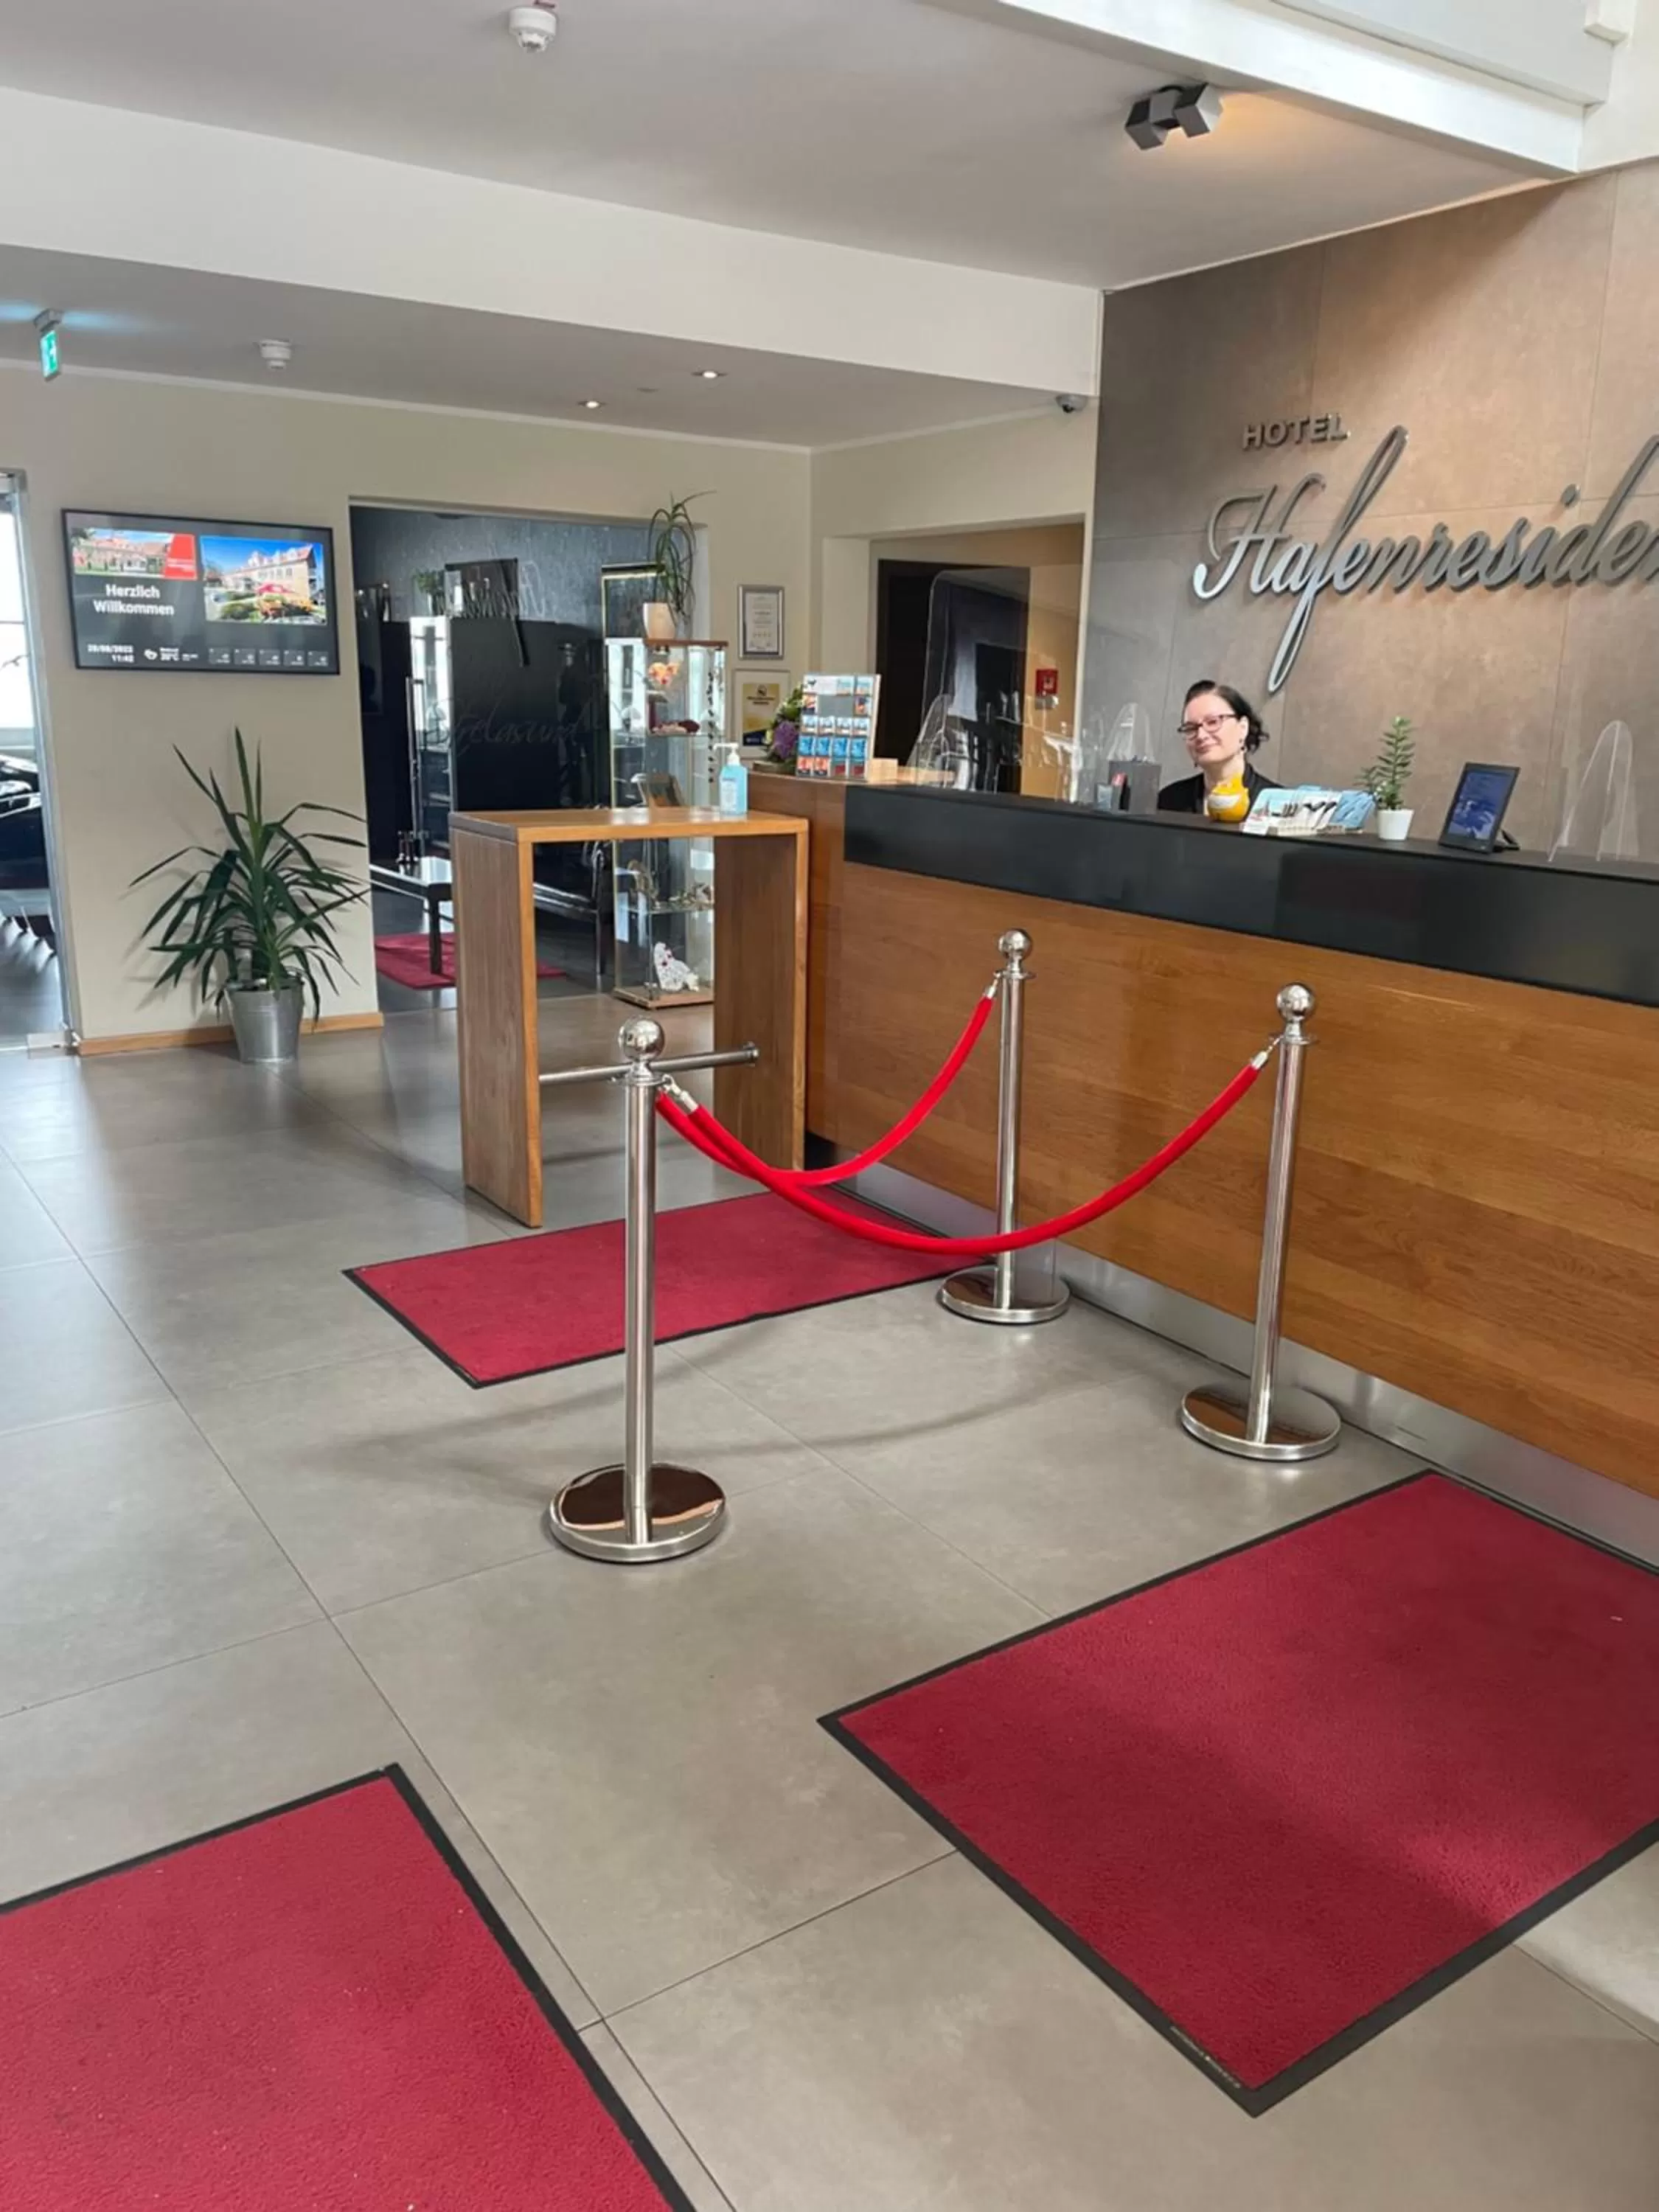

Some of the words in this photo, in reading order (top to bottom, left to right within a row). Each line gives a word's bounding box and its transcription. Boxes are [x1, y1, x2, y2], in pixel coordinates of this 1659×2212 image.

[1242, 413, 1351, 451] HOTEL
[105, 583, 161, 599] Herzlich
[93, 599, 175, 616] Willkommen
